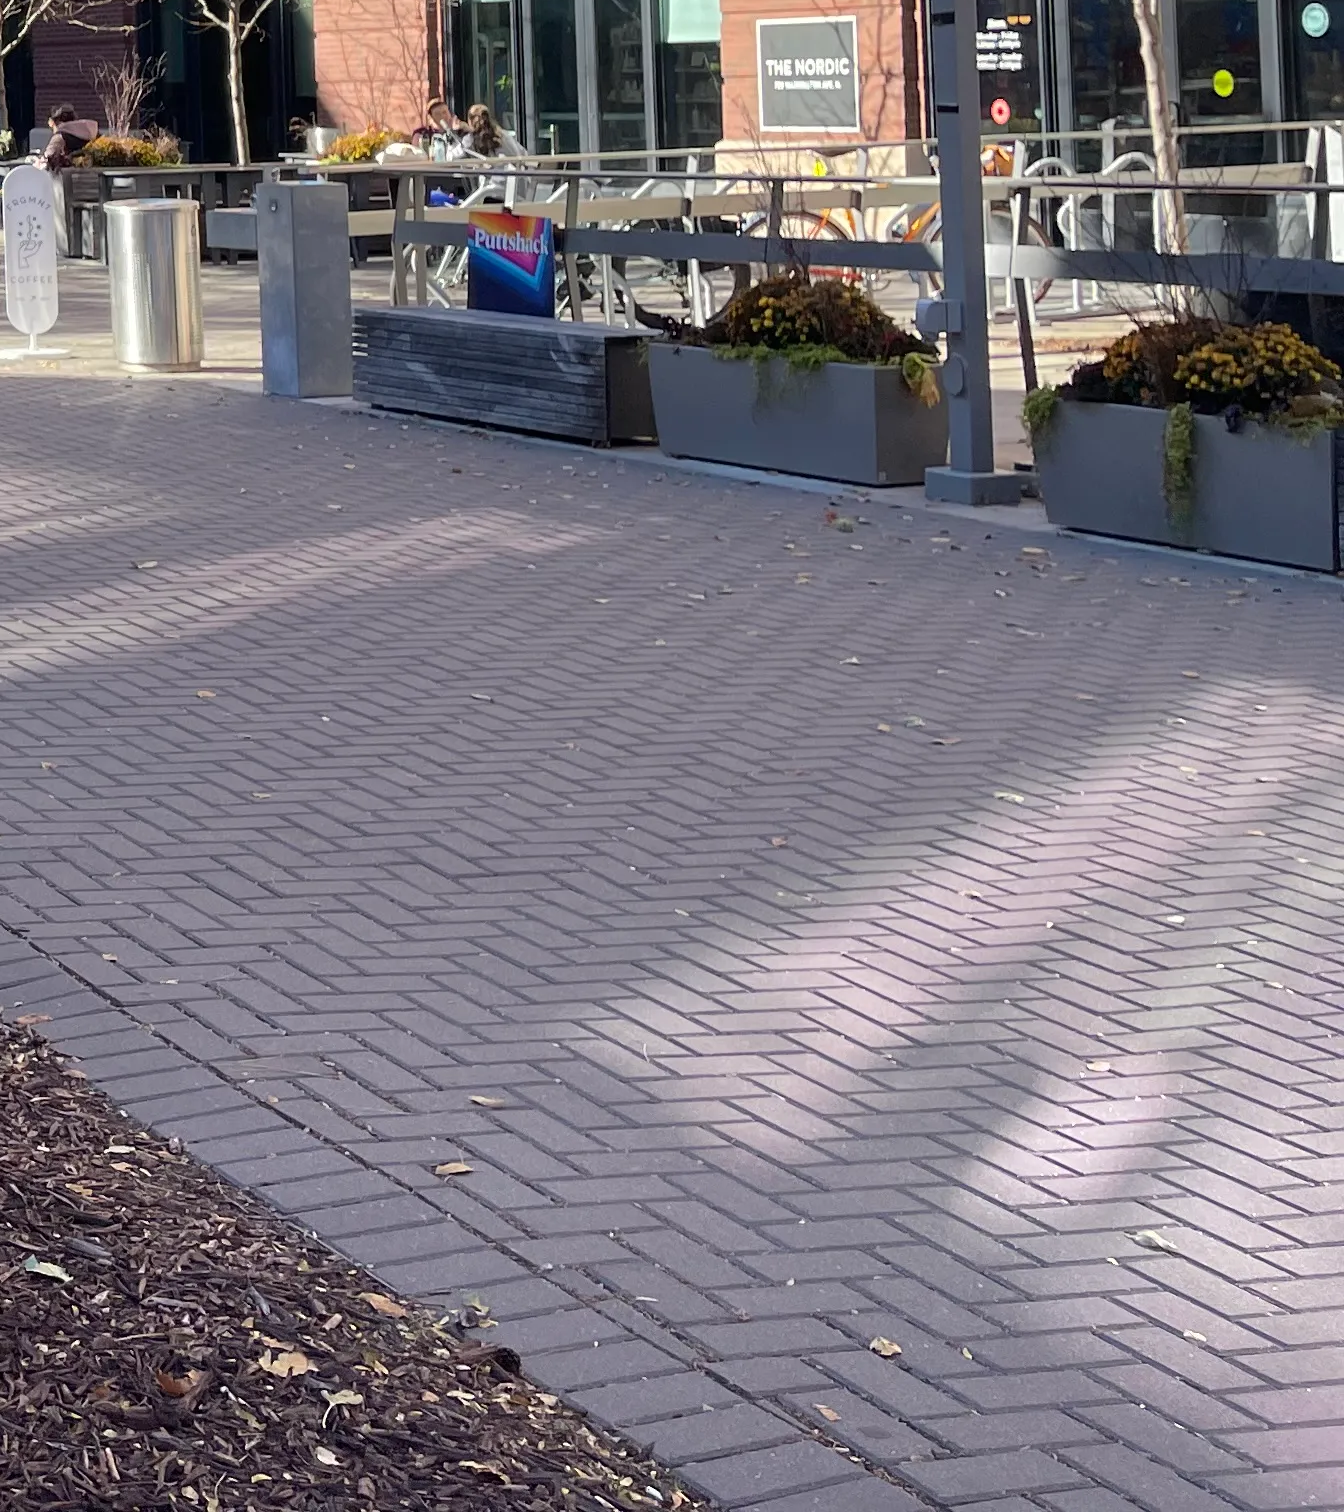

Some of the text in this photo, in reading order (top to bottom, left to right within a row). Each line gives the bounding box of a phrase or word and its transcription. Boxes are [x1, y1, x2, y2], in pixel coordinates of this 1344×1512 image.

[765, 57, 850, 77] THE NORDIC
[474, 227, 549, 256] Puttshack
[10, 275, 53, 285] COFFEE
